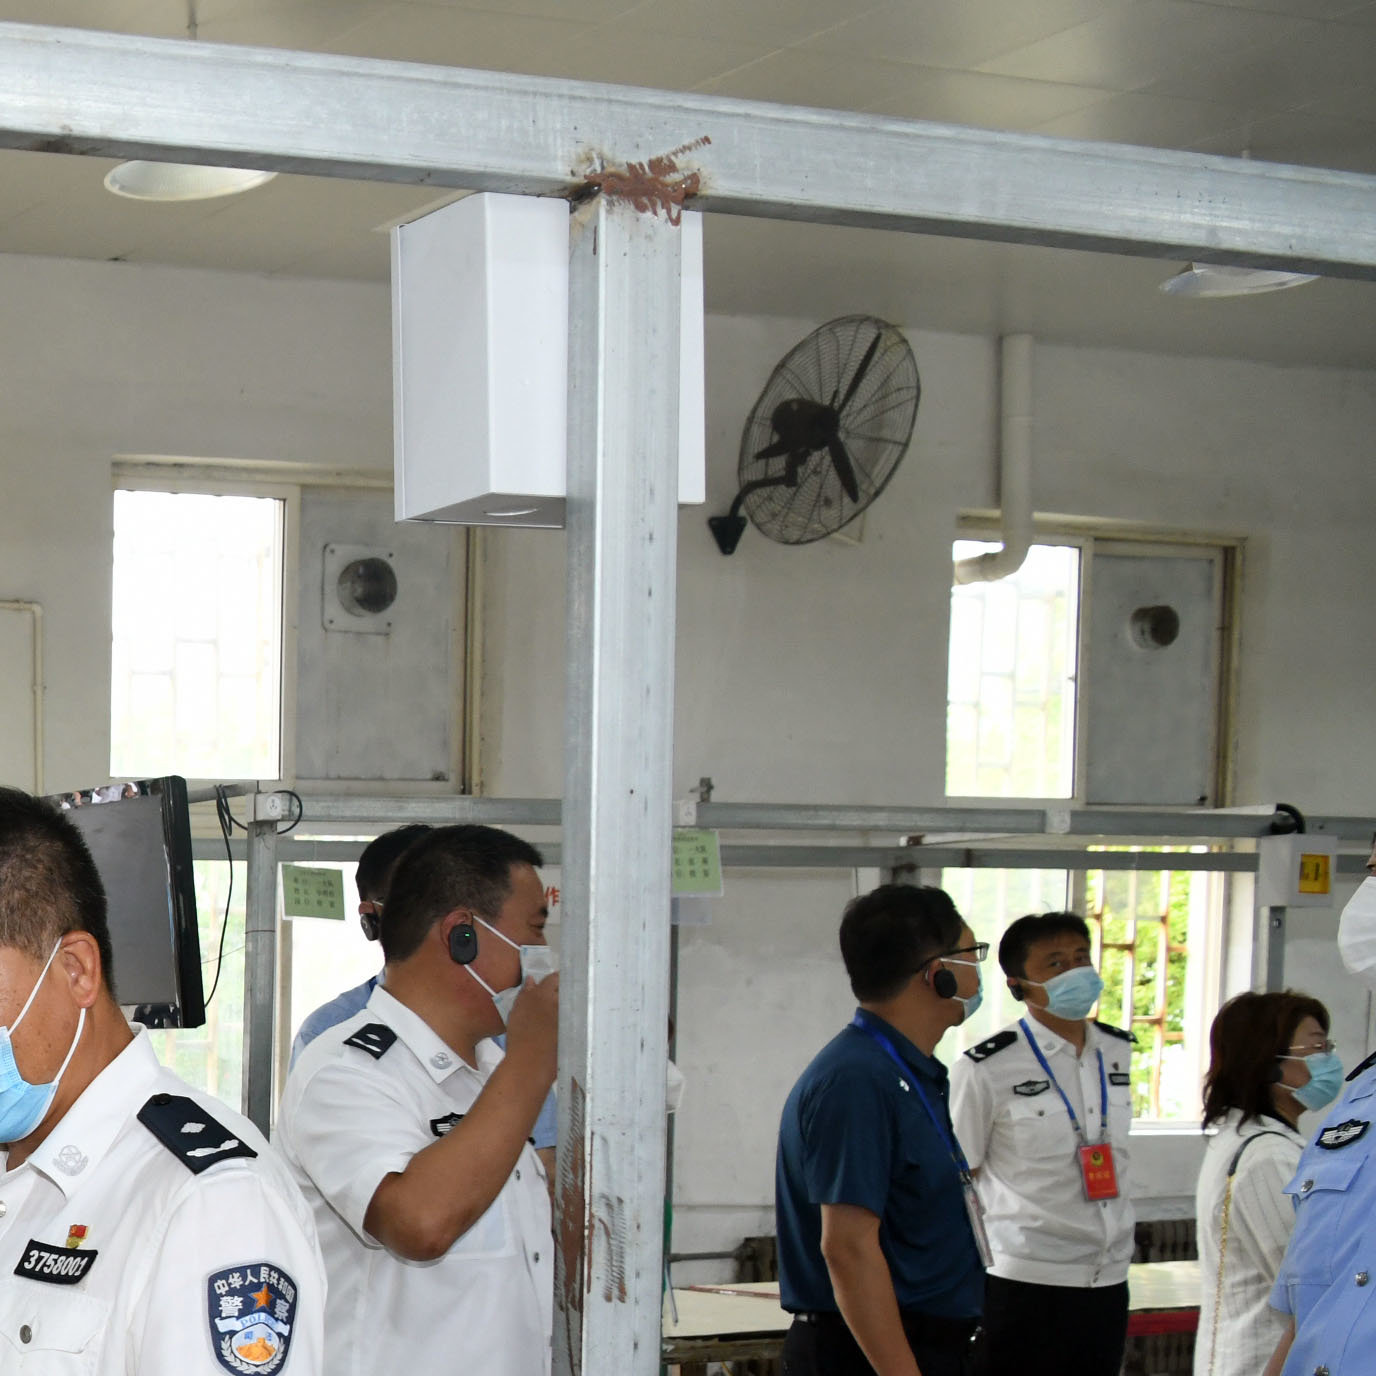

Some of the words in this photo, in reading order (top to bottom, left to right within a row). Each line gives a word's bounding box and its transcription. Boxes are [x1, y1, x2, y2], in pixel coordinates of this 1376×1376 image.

[23, 1249, 89, 1277] 3758001
[214, 1266, 296, 1304] 中华人民共和国
